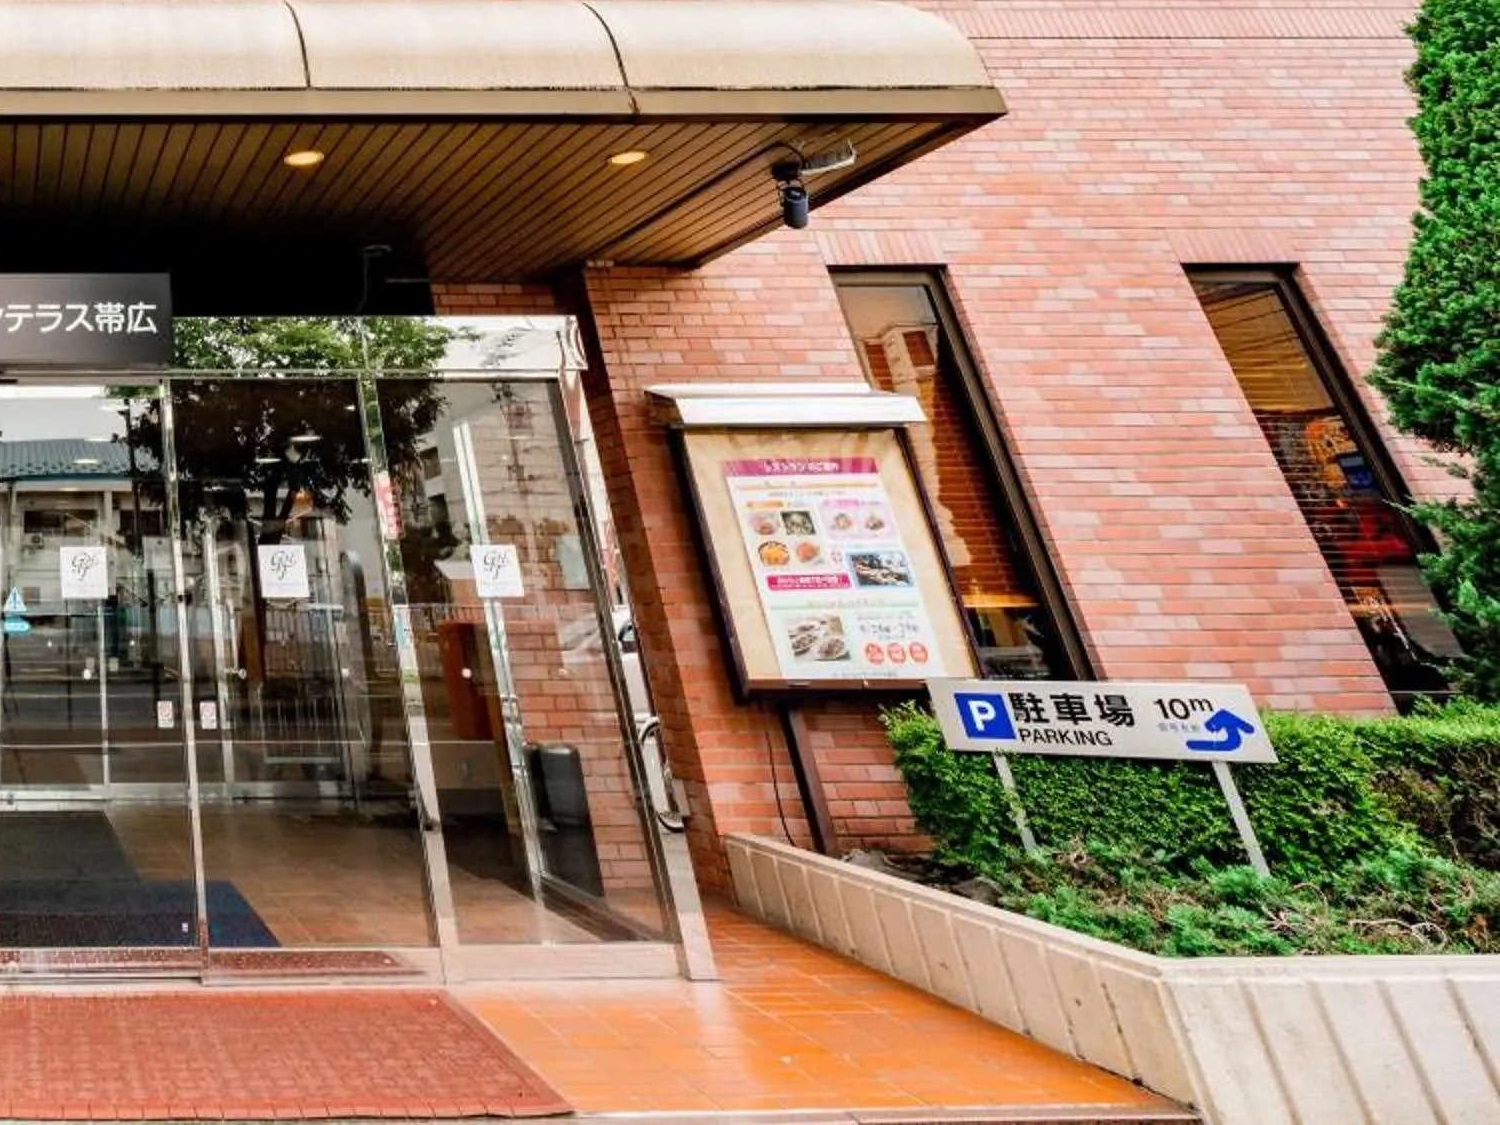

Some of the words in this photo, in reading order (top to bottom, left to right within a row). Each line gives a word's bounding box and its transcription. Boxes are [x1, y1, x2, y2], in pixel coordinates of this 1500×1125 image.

[967, 700, 996, 732] P
[1008, 692, 1136, 727] 駐車場
[1153, 698, 1214, 720] 10m
[1018, 727, 1113, 746] PARKING
